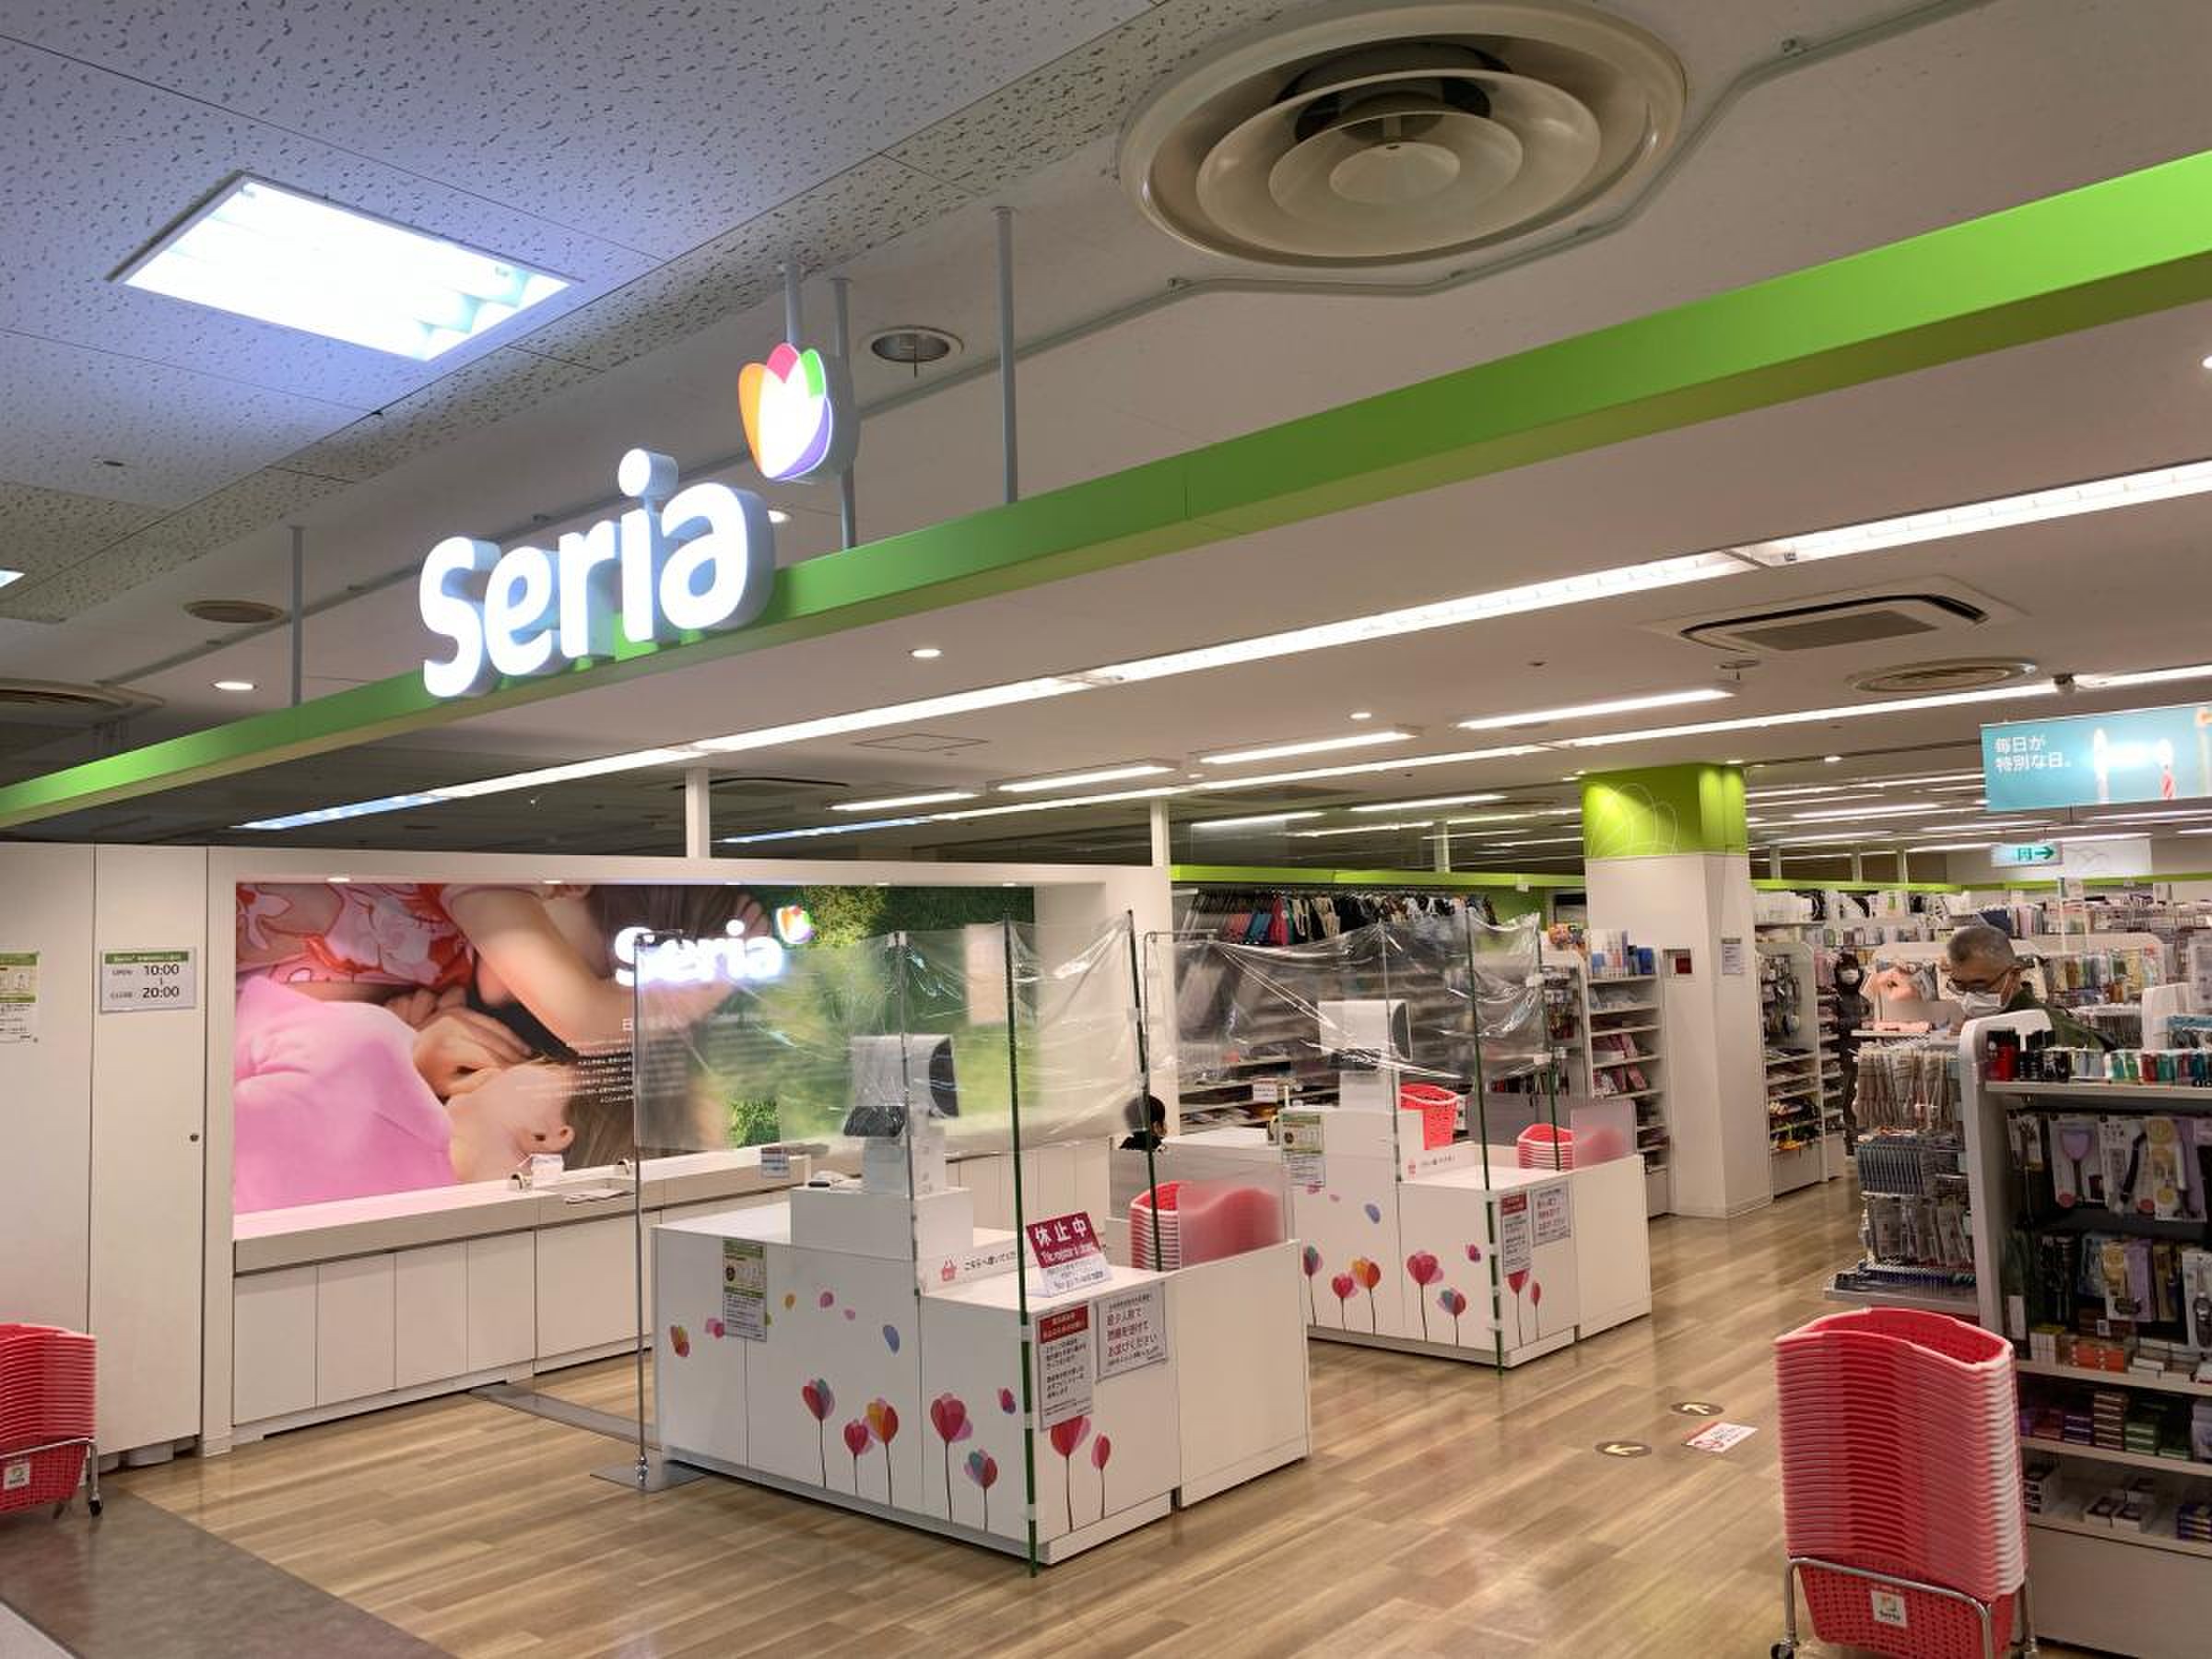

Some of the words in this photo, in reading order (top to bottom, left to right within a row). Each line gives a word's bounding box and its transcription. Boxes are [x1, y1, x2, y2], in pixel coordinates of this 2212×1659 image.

[419, 448, 756, 698] Seria
[1994, 734, 2045, 753] 毎日が
[1994, 751, 2071, 773] 特別な日。
[143, 963, 180, 977] 10:00
[142, 986, 180, 999] 20:00
[1034, 1217, 1088, 1248] 休止中
